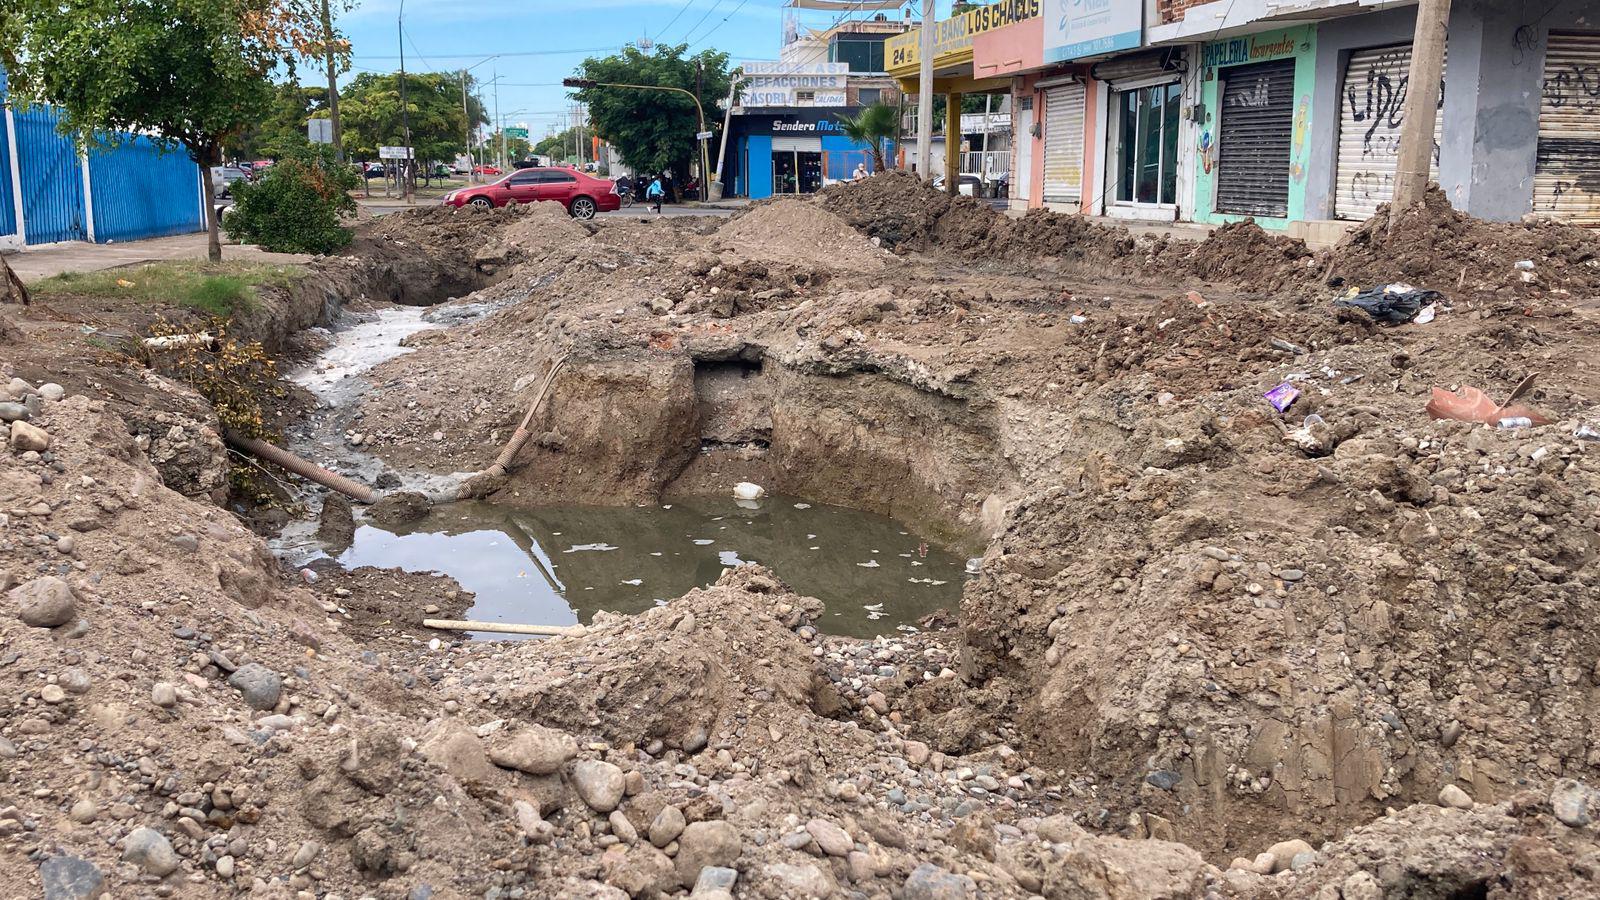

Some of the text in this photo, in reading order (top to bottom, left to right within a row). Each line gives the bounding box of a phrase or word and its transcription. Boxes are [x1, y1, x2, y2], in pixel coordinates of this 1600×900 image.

[968, 7, 989, 34] LOS
[893, 47, 905, 66] 24
[1205, 39, 1248, 67] PAPELERIA
[772, 120, 815, 131] Sendero
